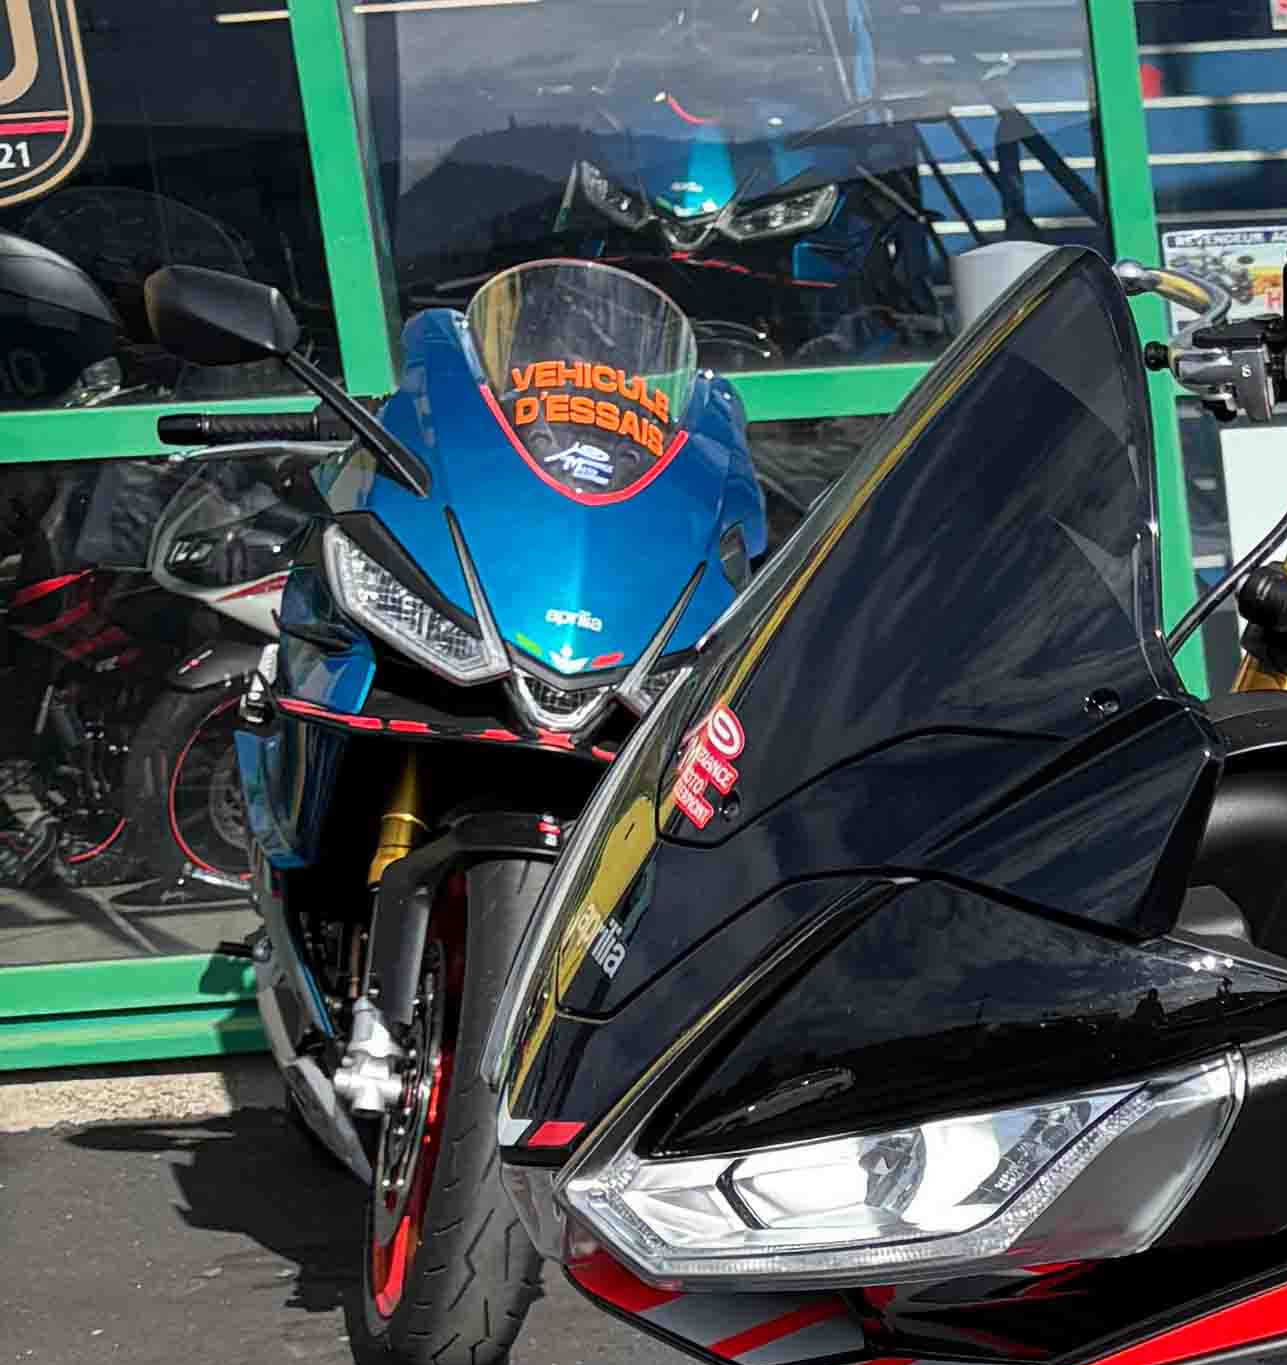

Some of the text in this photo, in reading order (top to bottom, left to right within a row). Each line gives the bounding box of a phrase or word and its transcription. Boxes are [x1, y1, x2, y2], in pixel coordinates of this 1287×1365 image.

[512, 361, 669, 424] VEHICULE
[515, 391, 663, 457] D'ESSAIS
[545, 609, 602, 633] aprilia
